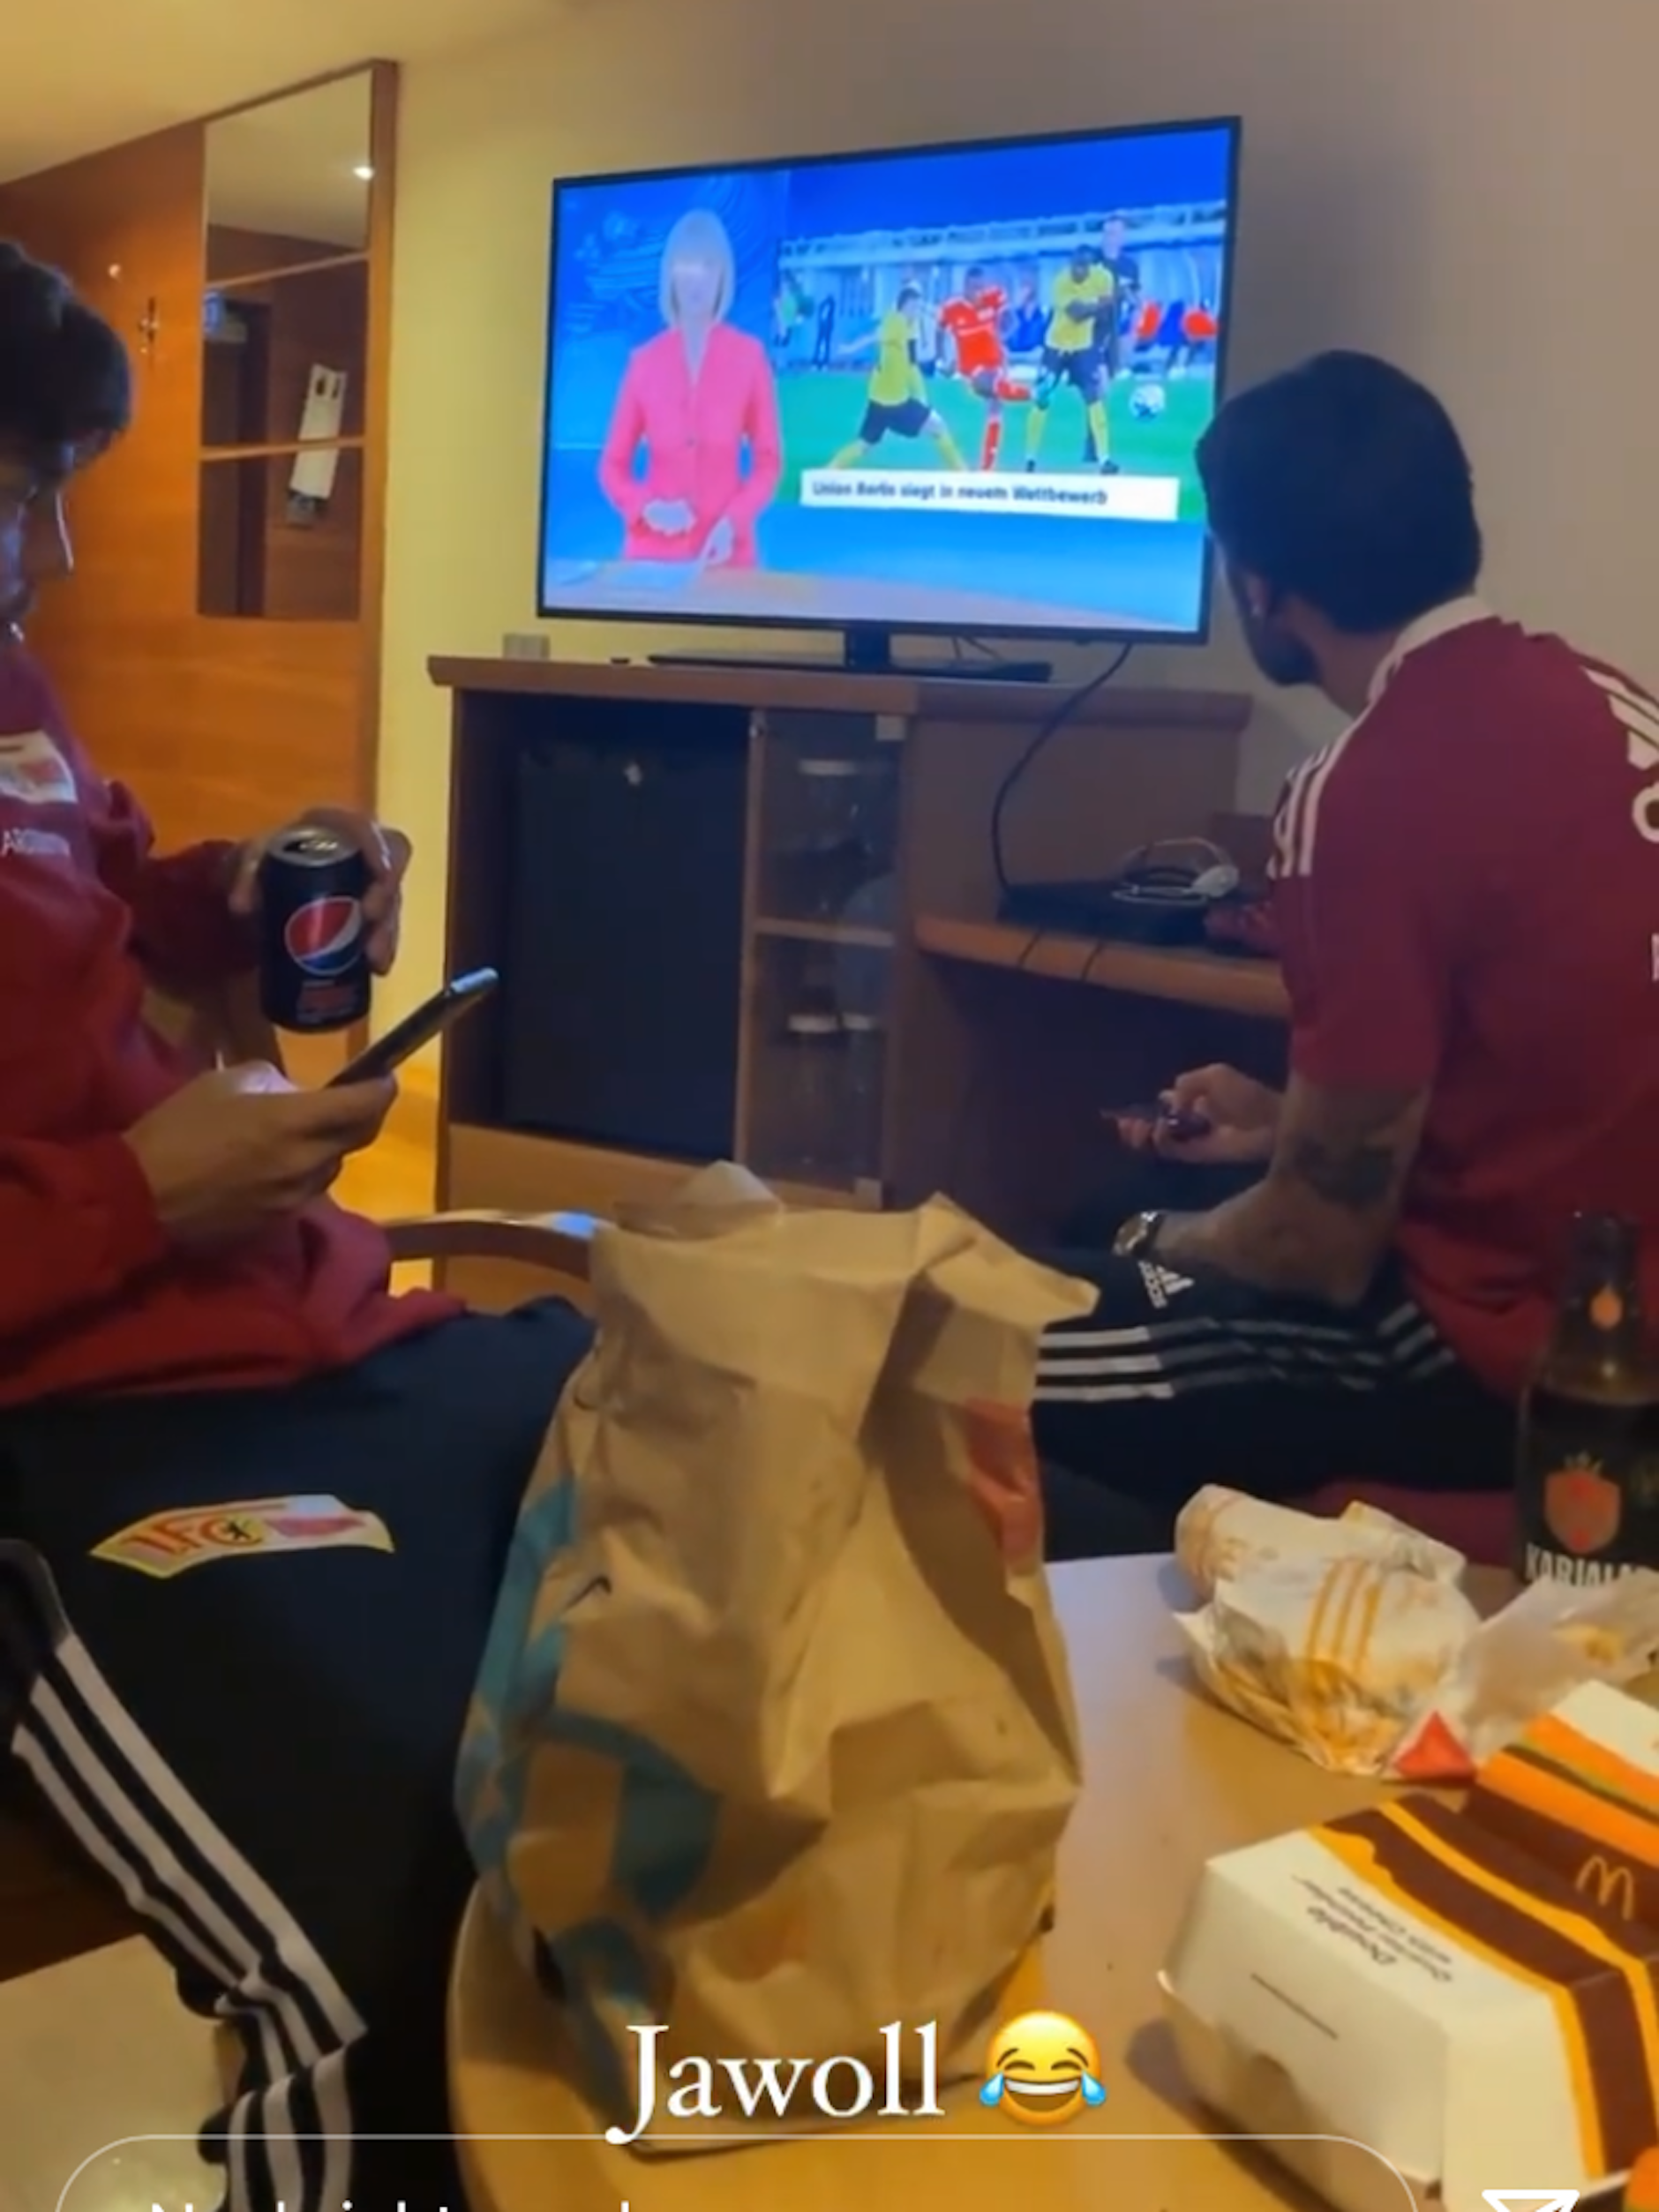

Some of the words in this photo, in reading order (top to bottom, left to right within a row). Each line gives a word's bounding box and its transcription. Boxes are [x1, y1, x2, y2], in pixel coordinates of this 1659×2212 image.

[812, 482, 852, 496] Union
[857, 481, 896, 497] Berlin
[901, 483, 935, 500] siegt
[940, 483, 953, 499] in
[957, 485, 1008, 499] neuem
[1012, 484, 1108, 506] Wettbewerb
